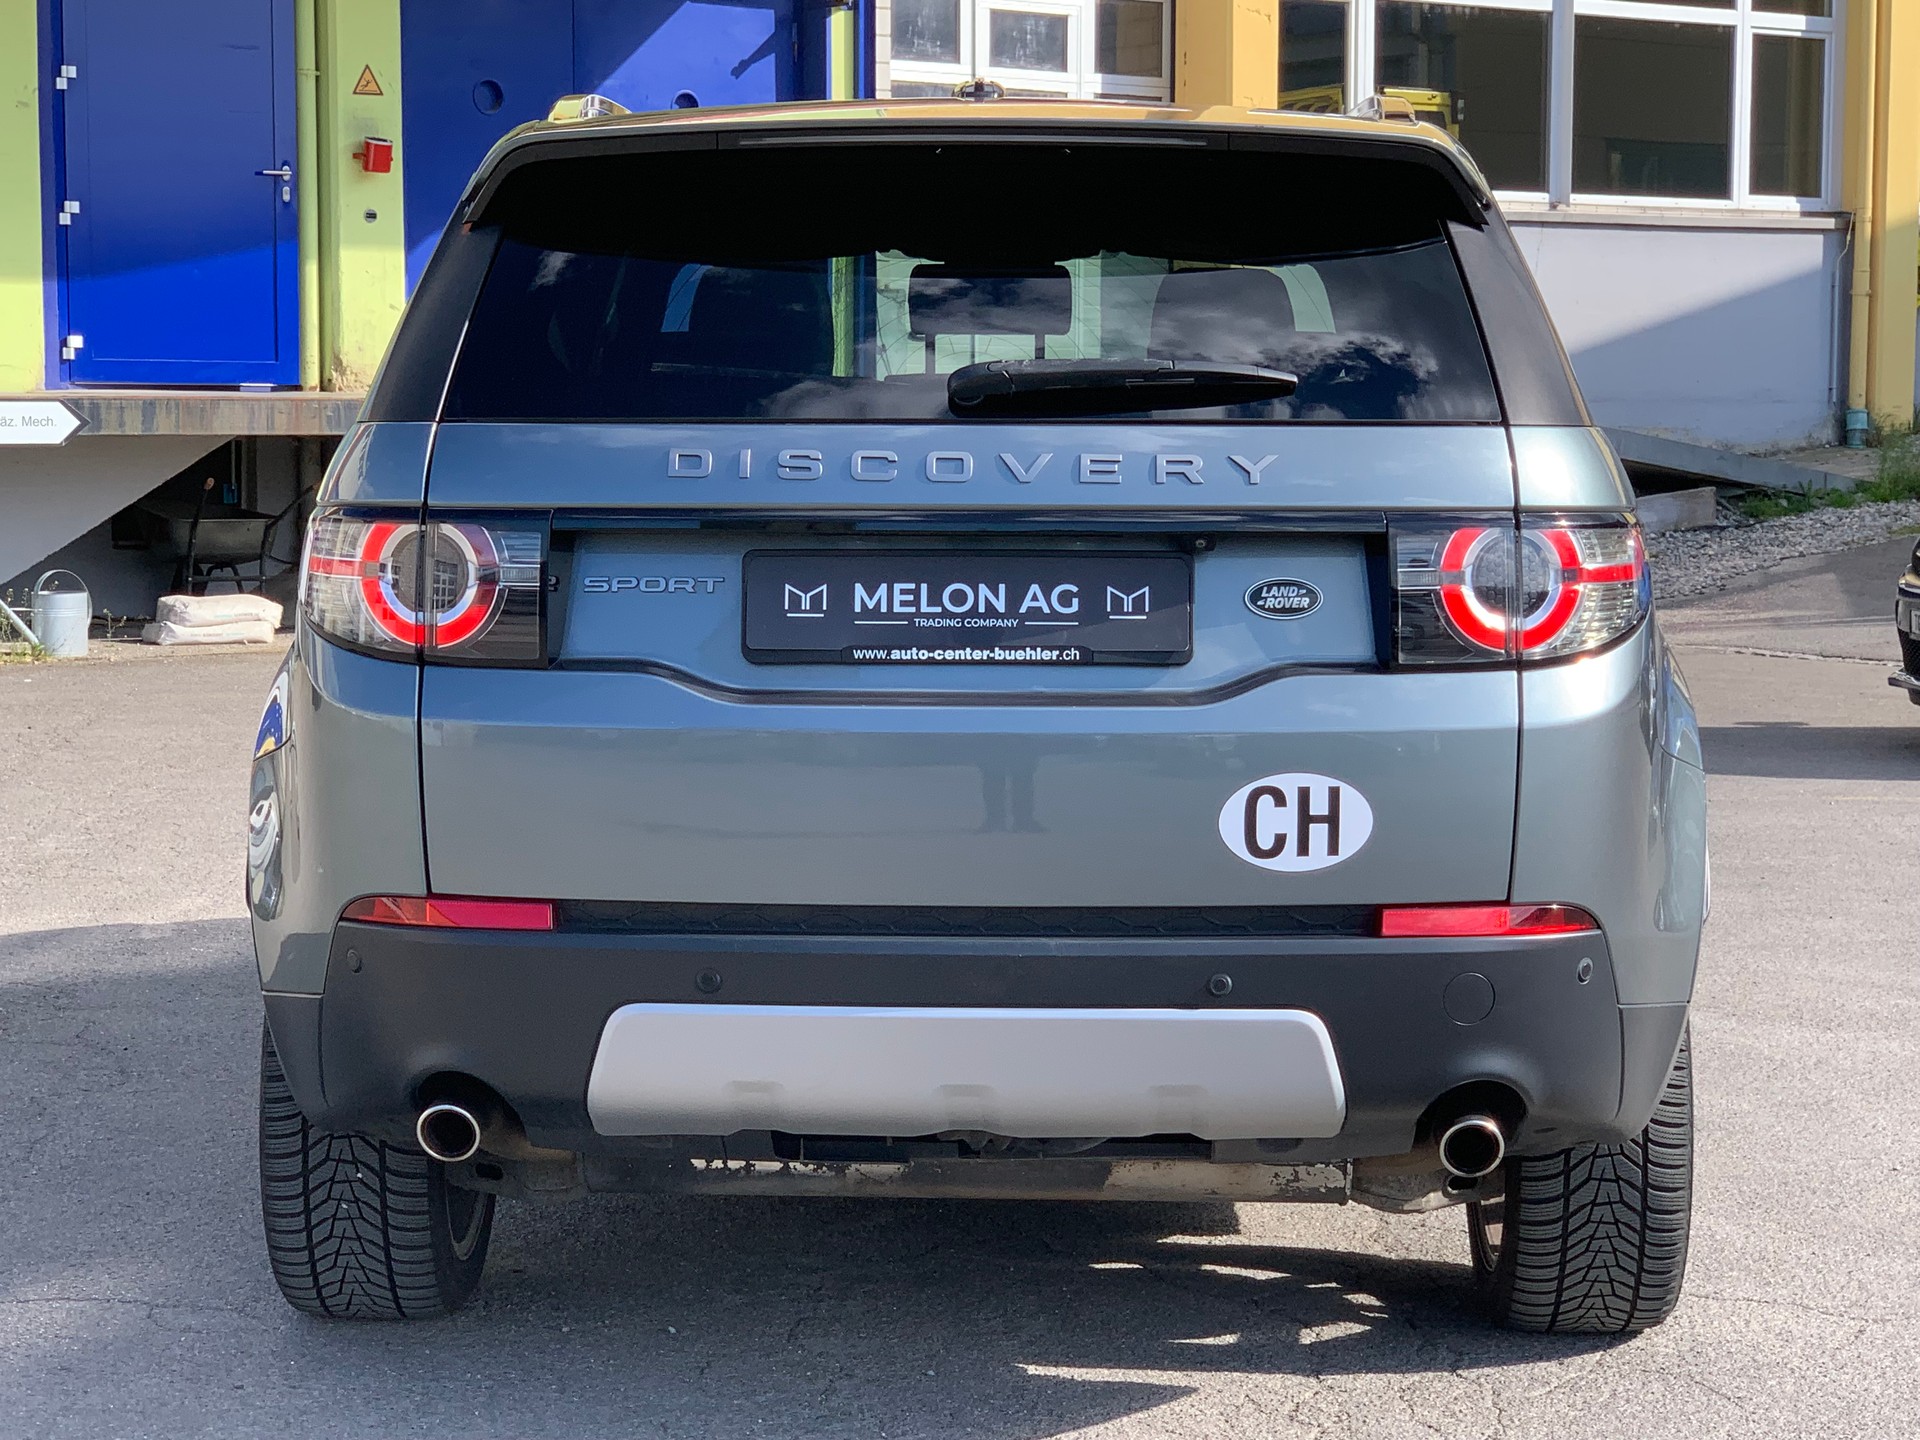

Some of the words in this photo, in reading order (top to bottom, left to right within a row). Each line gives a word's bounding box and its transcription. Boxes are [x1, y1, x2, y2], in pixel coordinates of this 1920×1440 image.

[21, 415, 57, 427] Mech.
[667, 448, 1280, 485] DISCOVERY
[583, 576, 725, 593] SPORT
[854, 582, 1006, 613] MELON
[1018, 583, 1080, 614] AG
[913, 618, 962, 628] TRADING
[964, 618, 1019, 628] COMPANY
[852, 647, 1080, 661] www.auto-center-buehler.ch
[1243, 785, 1341, 860] CH
